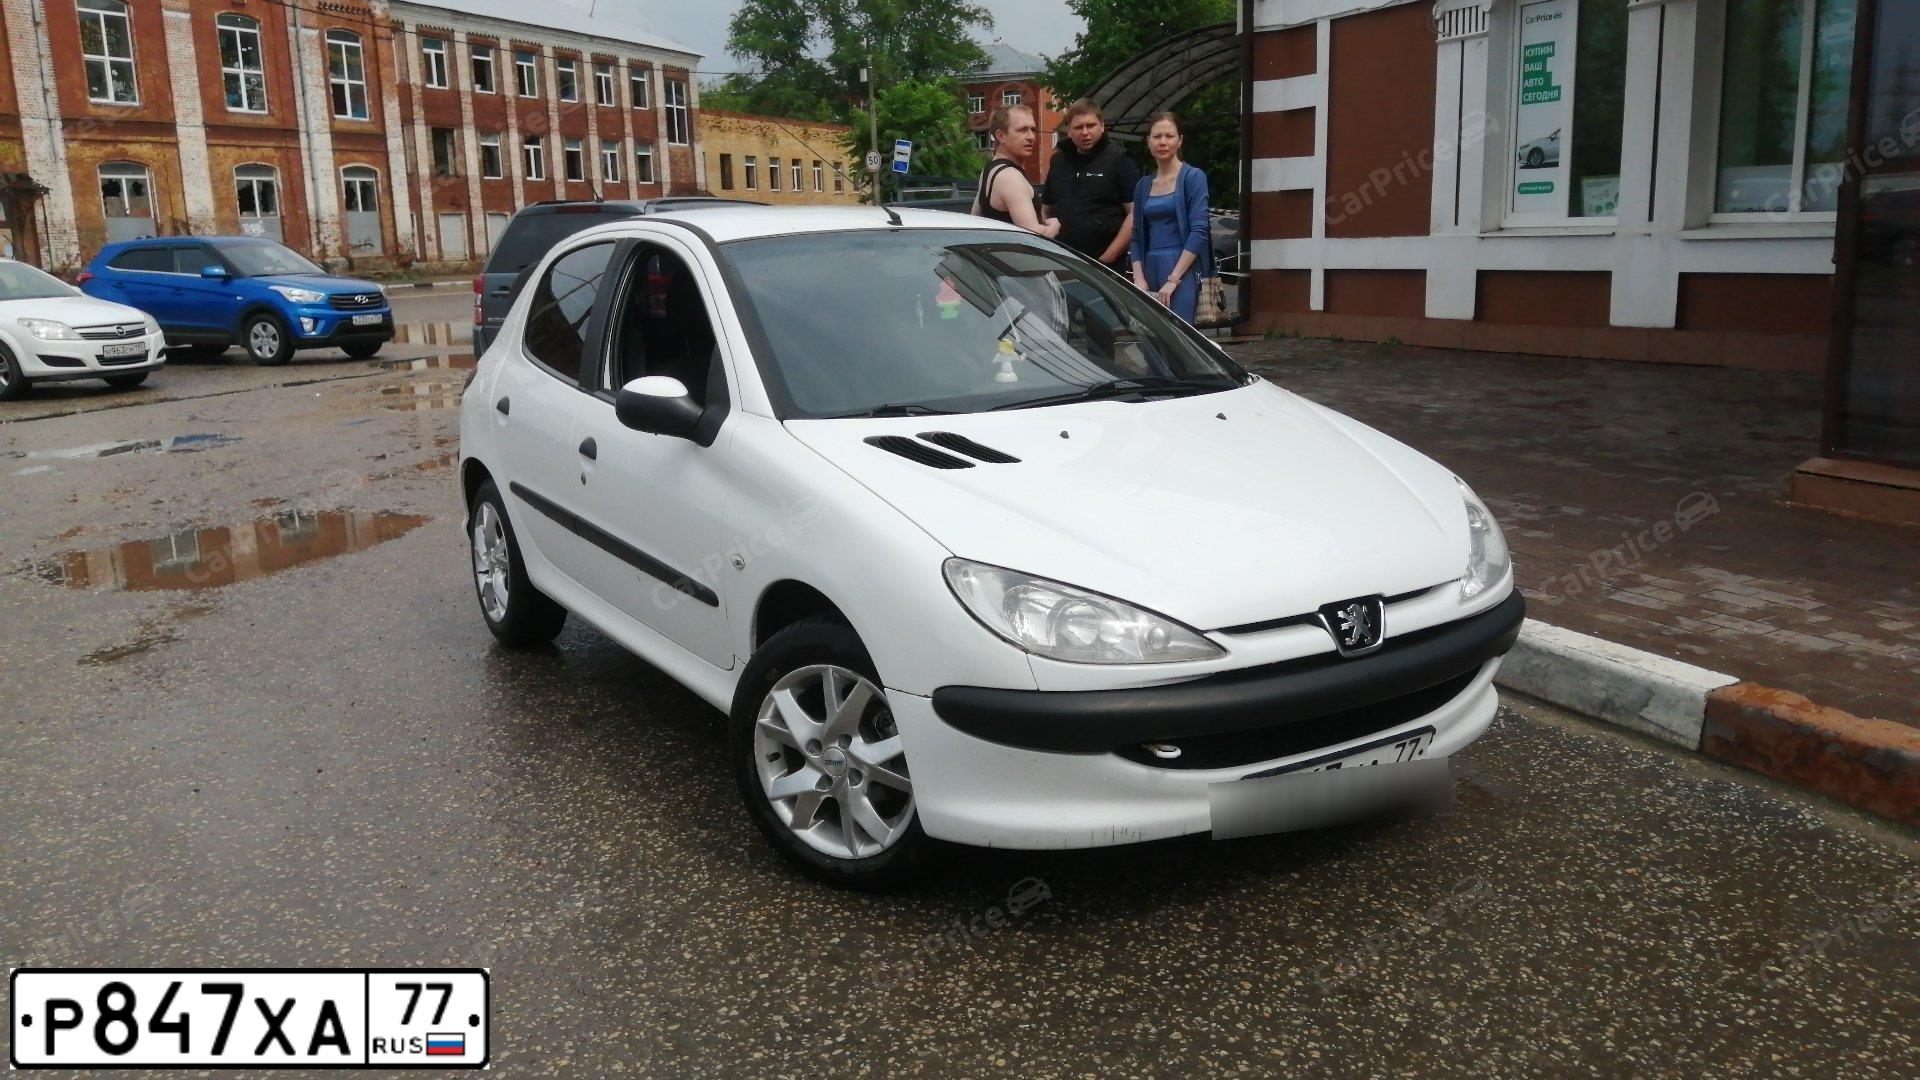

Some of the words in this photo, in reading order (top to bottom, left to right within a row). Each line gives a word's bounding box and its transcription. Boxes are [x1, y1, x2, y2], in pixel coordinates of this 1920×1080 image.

[1525, 14, 1553, 24] CarPrice
[1525, 45, 1553, 58] КУПИМ
[1524, 62, 1543, 72] ВАШ
[1523, 77, 1544, 88] АВТО
[1523, 89, 1559, 102] СЕГОДНЯ
[868, 155, 879, 165] 50
